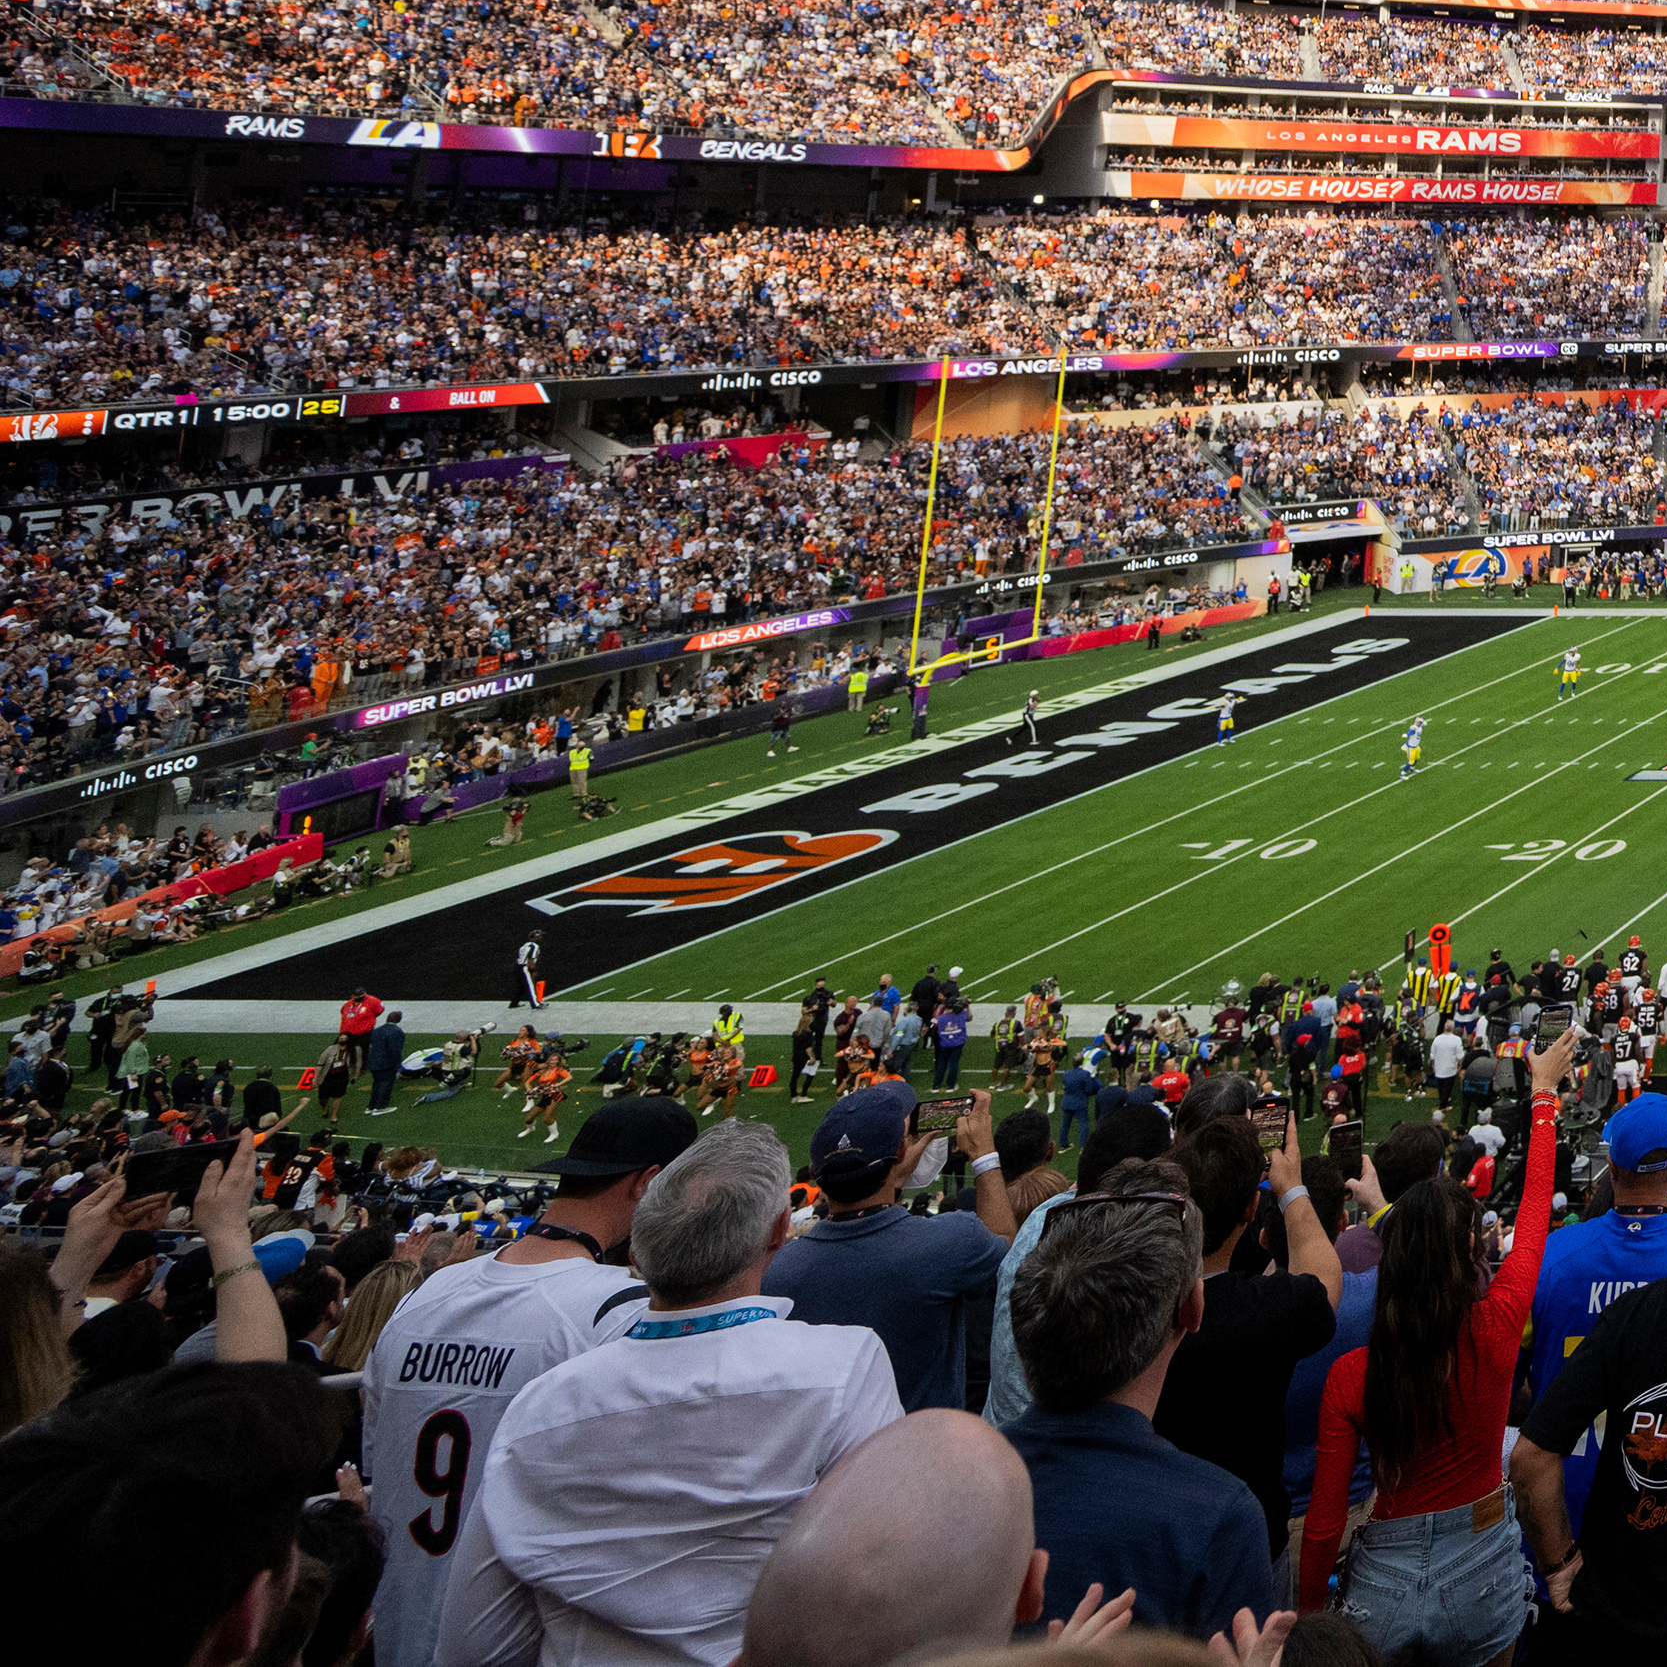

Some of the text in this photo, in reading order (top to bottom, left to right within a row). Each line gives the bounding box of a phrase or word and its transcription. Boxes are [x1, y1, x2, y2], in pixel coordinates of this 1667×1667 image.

[1363, 84, 1395, 94] RAMS
[225, 116, 305, 138] RAMS
[700, 139, 807, 162] BENGALS
[1267, 129, 1522, 153] LOS ANGELES RAMS
[1213, 177, 1563, 201] WHOSE HOUSE? RAMS HOUSE!
[1294, 349, 1341, 362] CISCO
[1412, 343, 1546, 358] SUPER BOWL
[1604, 342, 1651, 354] SUPER
[769, 370, 822, 386] CISCO
[952, 361, 999, 377] LOS
[211, 401, 290, 422] 15:00
[302, 399, 341, 417] 25
[1483, 531, 1591, 549] SUPER BOWL
[1163, 552, 1199, 566] CISCO
[1017, 572, 1051, 588] CISCO
[700, 610, 834, 650] LOS ANGELES
[364, 673, 534, 725] SUPER BOWL LVI
[859, 634, 1413, 817] BENGALS
[145, 754, 198, 779] CISCO
[675, 747, 932, 822] IT TAKES
[1623, 956, 1640, 971] 92
[1561, 975, 1579, 991] 24
[398, 1341, 517, 1390] BURROW
[409, 1408, 473, 1556] 9
